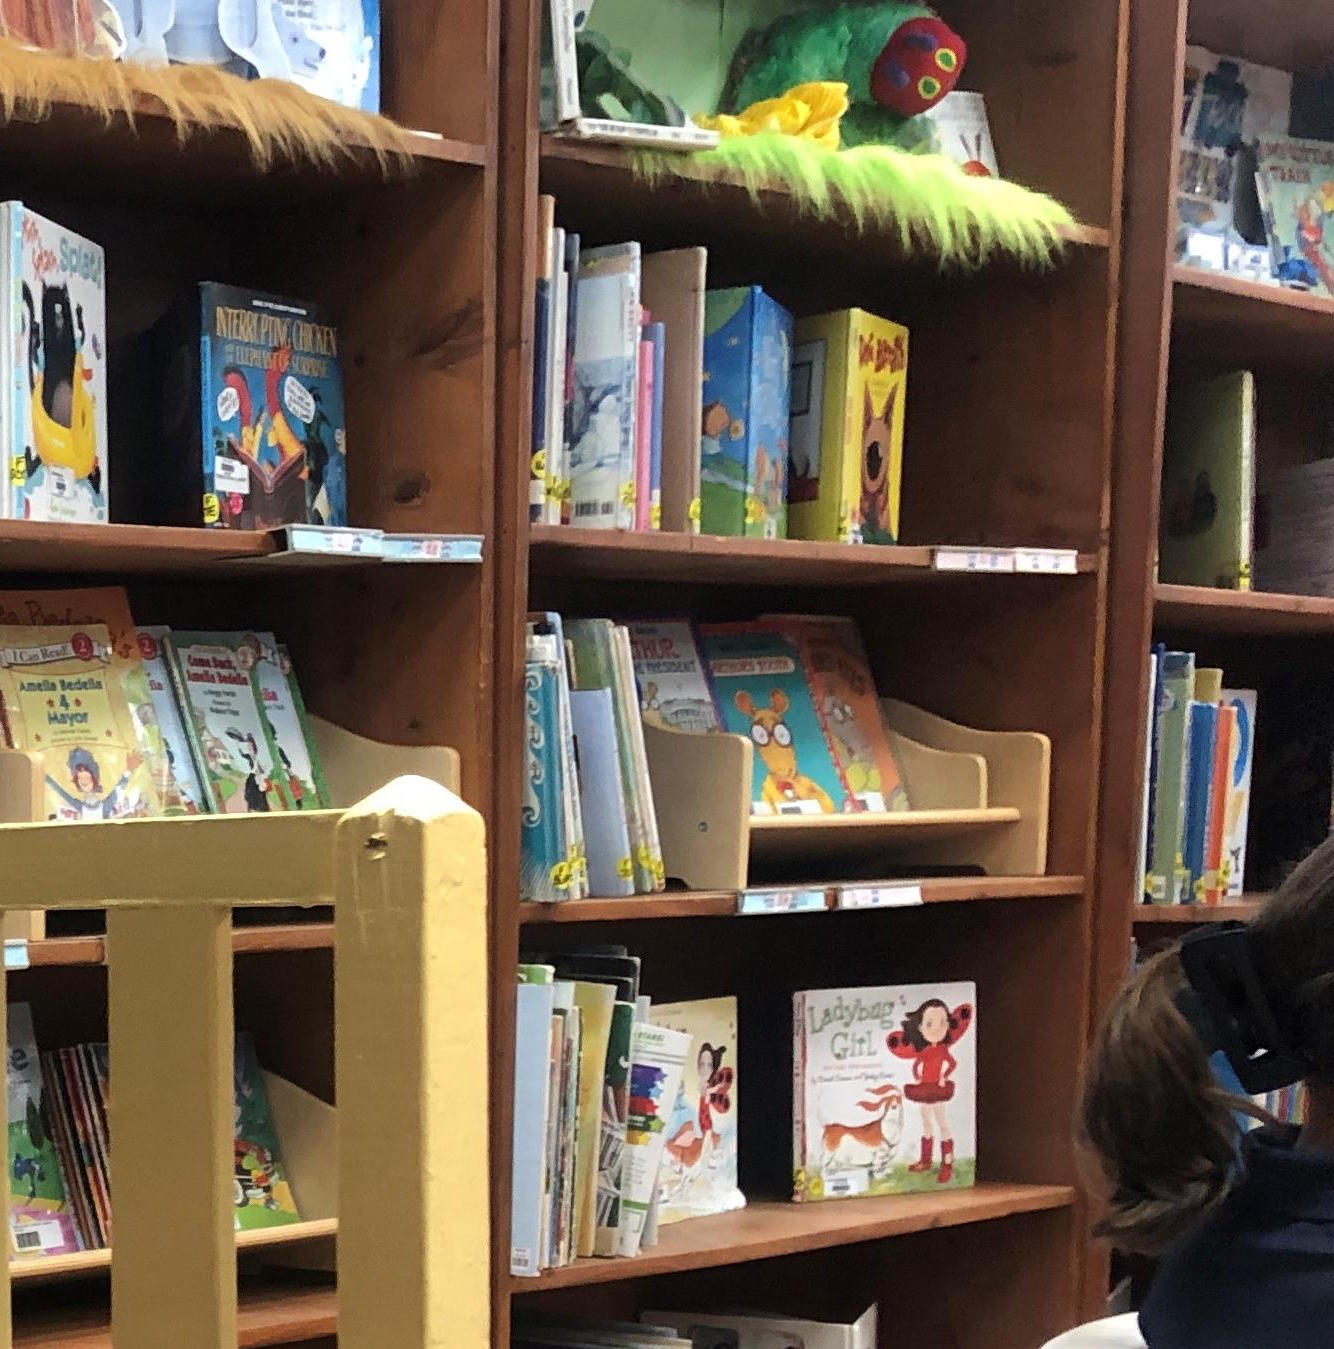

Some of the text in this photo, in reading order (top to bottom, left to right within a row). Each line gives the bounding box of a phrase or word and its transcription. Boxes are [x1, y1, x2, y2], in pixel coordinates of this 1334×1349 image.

[59, 237, 103, 290] Splat!
[19, 650, 39, 662] Can
[40, 644, 68, 659] Read!
[78, 640, 87, 652] 2
[632, 638, 681, 660] THUR
[187, 654, 211, 667] Come
[20, 678, 103, 692] Amelia Bedelia
[187, 671, 250, 686] Amelia Bedelia
[59, 694, 70, 711] 4
[47, 711, 89, 726] Mayor
[808, 995, 896, 1034] Ladybug
